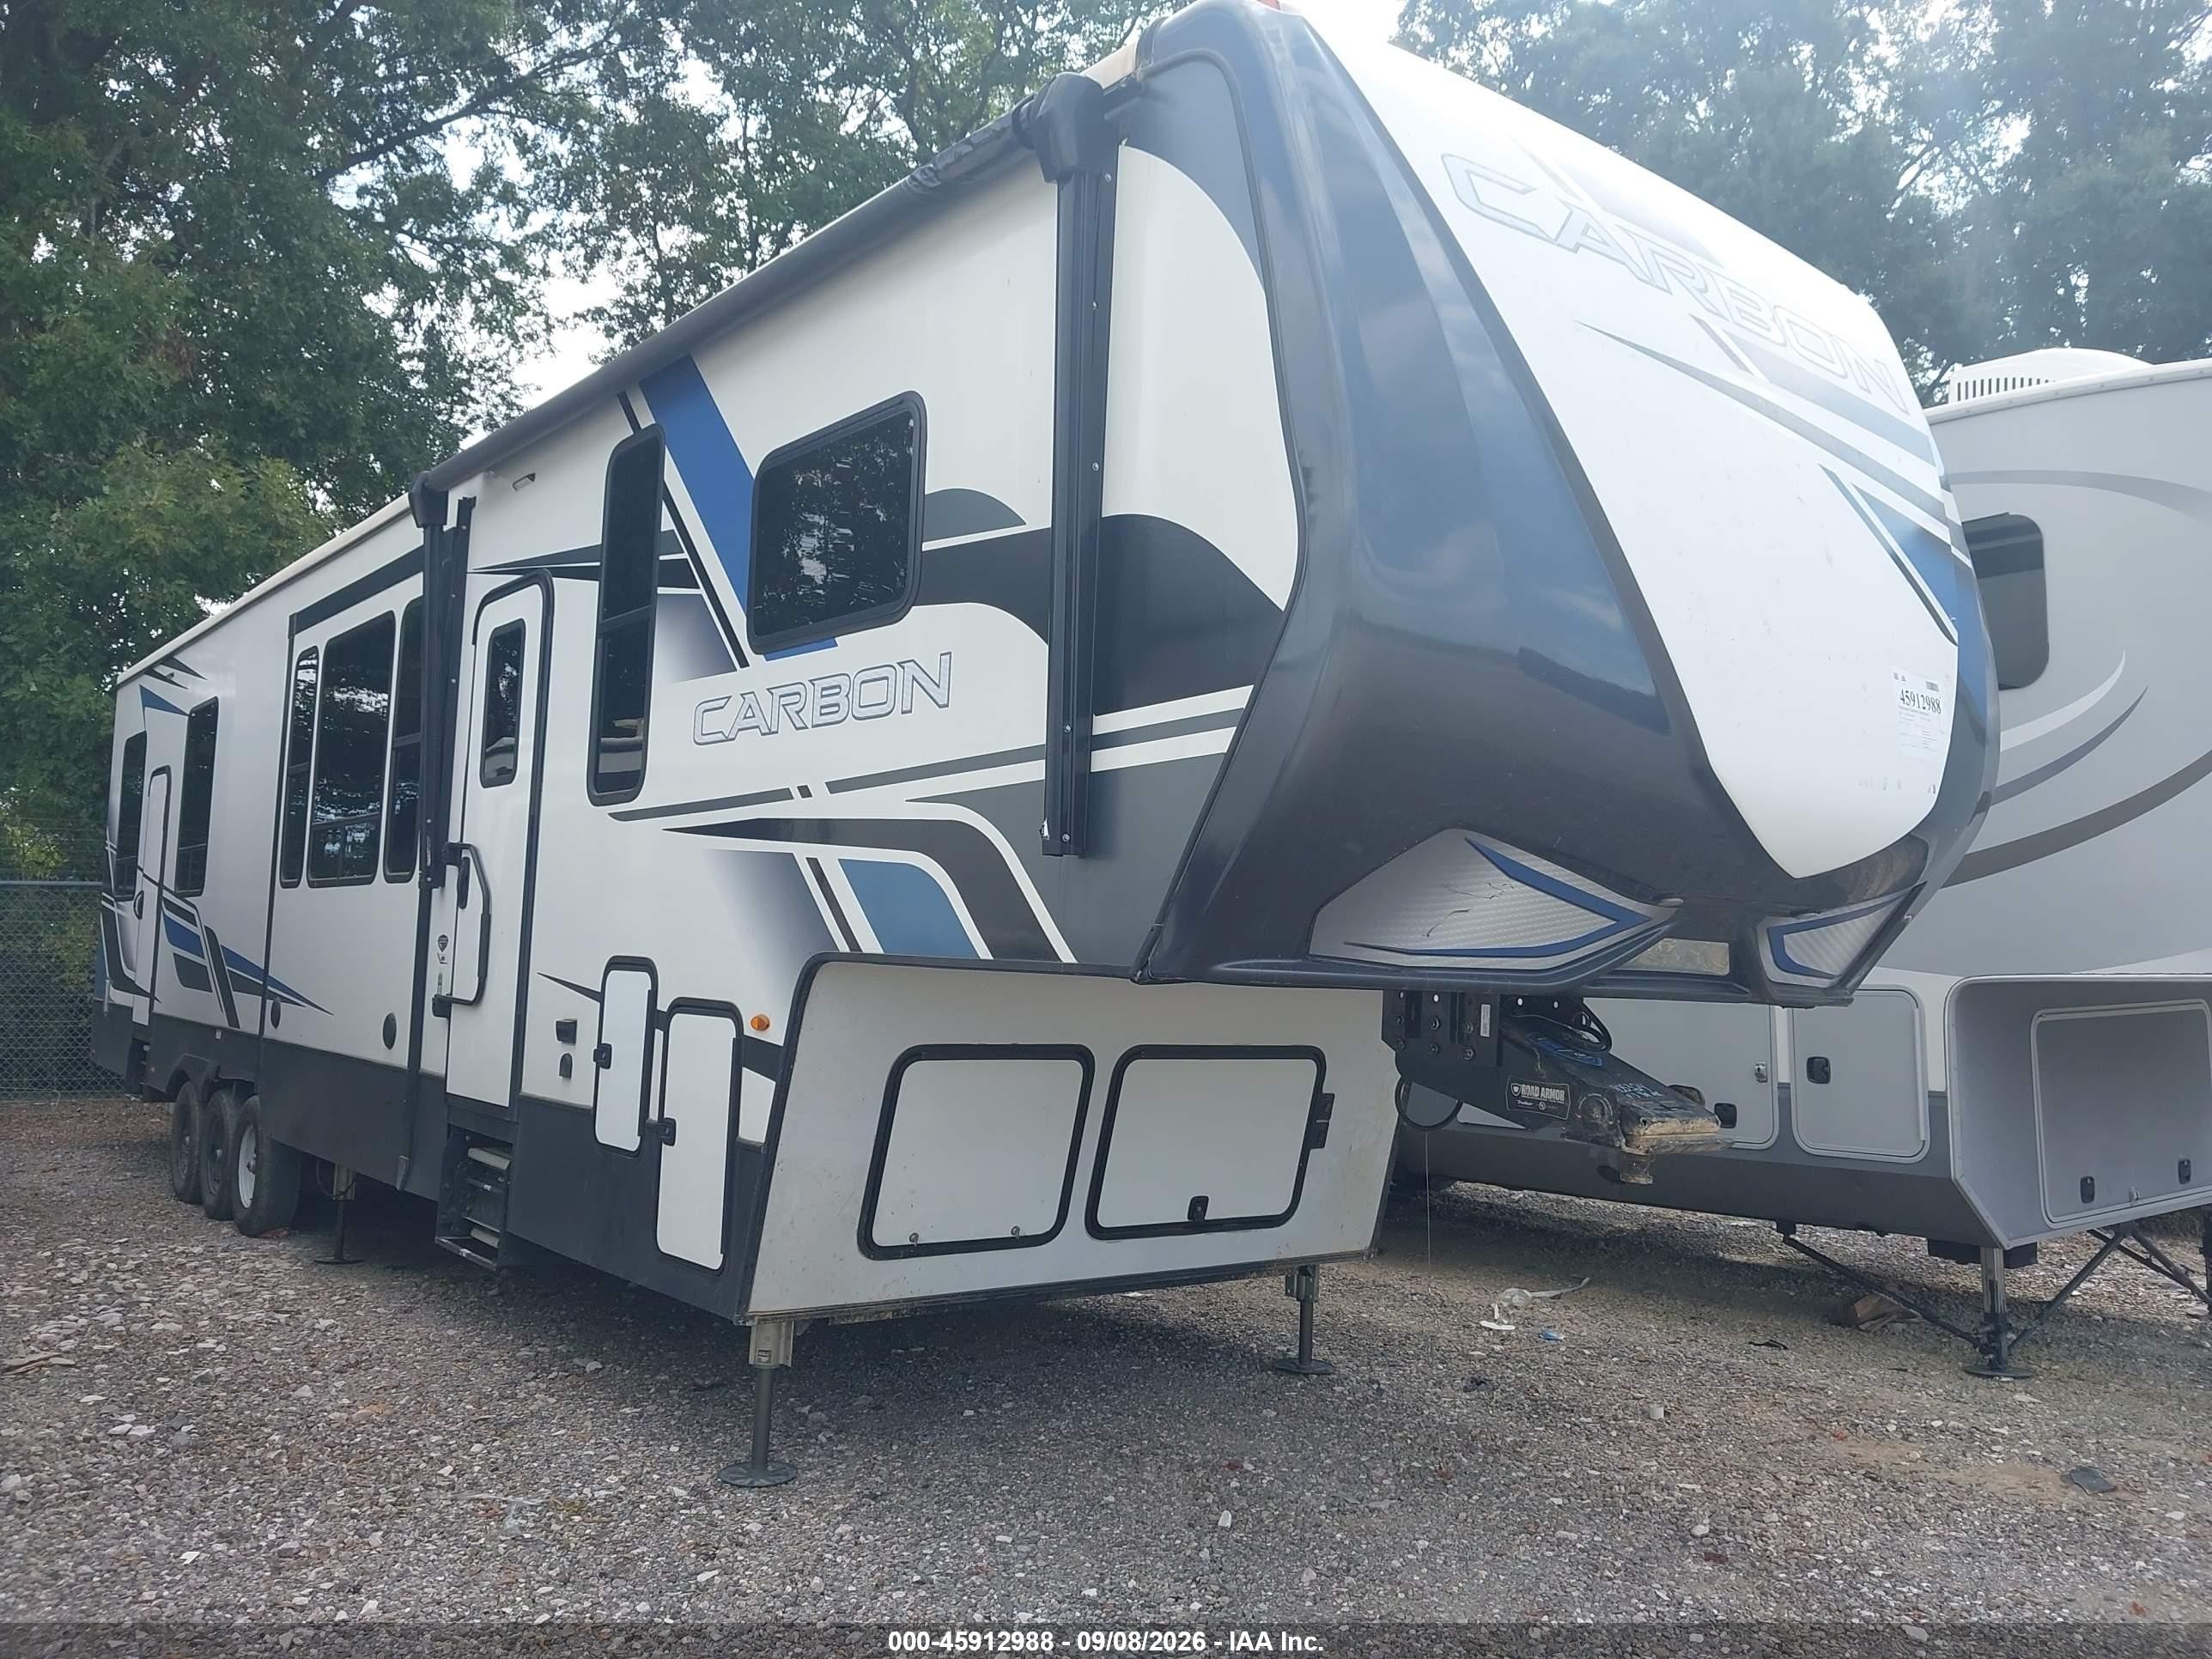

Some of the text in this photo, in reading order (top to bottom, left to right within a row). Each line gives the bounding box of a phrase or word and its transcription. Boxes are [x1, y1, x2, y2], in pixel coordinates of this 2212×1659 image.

[1441, 152, 1910, 416] CARBON
[693, 651, 951, 745] CARBON
[1899, 688, 1942, 714] 45912988
[1521, 1084, 1540, 1097] ROAD
[1540, 1086, 1565, 1101] ARMOR
